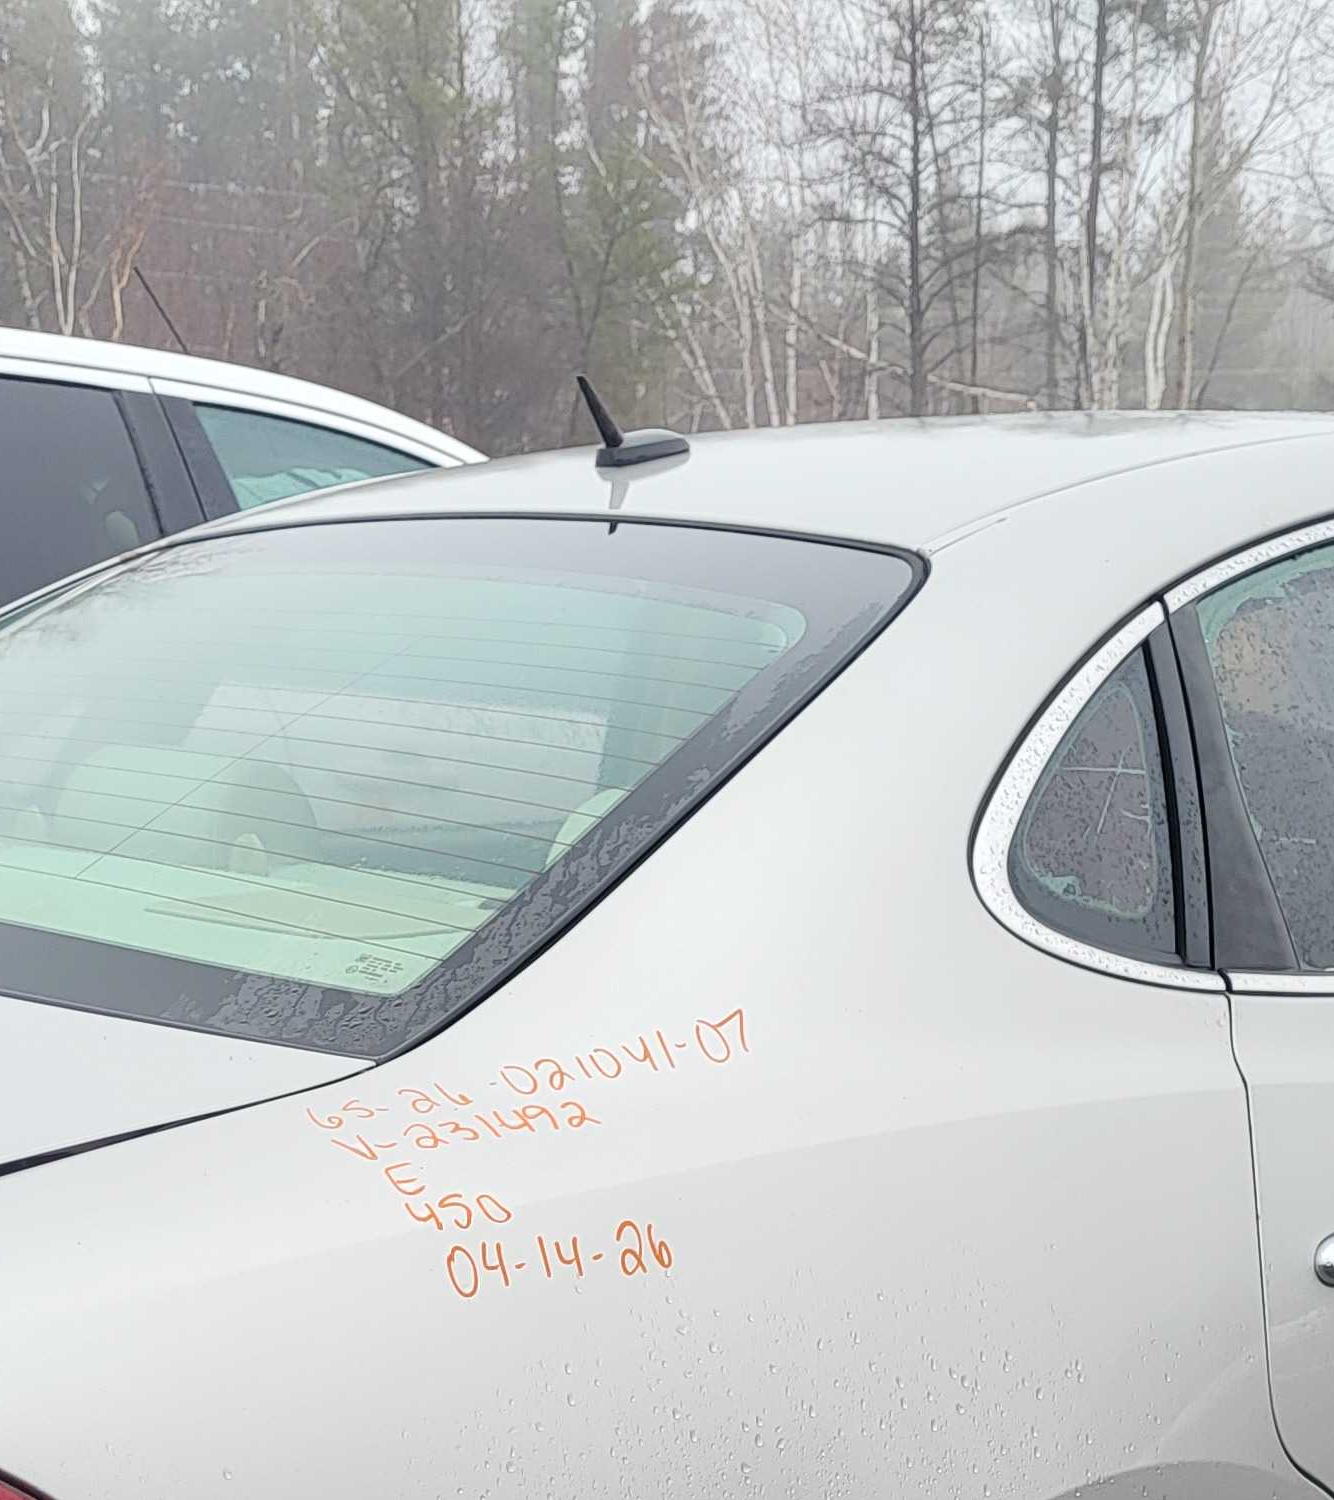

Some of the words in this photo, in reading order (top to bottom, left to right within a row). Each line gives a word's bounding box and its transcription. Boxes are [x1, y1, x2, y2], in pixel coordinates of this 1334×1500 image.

[307, 1009, 750, 1129] 65-26-021041-07
[332, 1102, 602, 1160] V-231492
[385, 1162, 426, 1195] E
[405, 1193, 513, 1230] 450
[446, 1220, 673, 1298] 04-14-26
